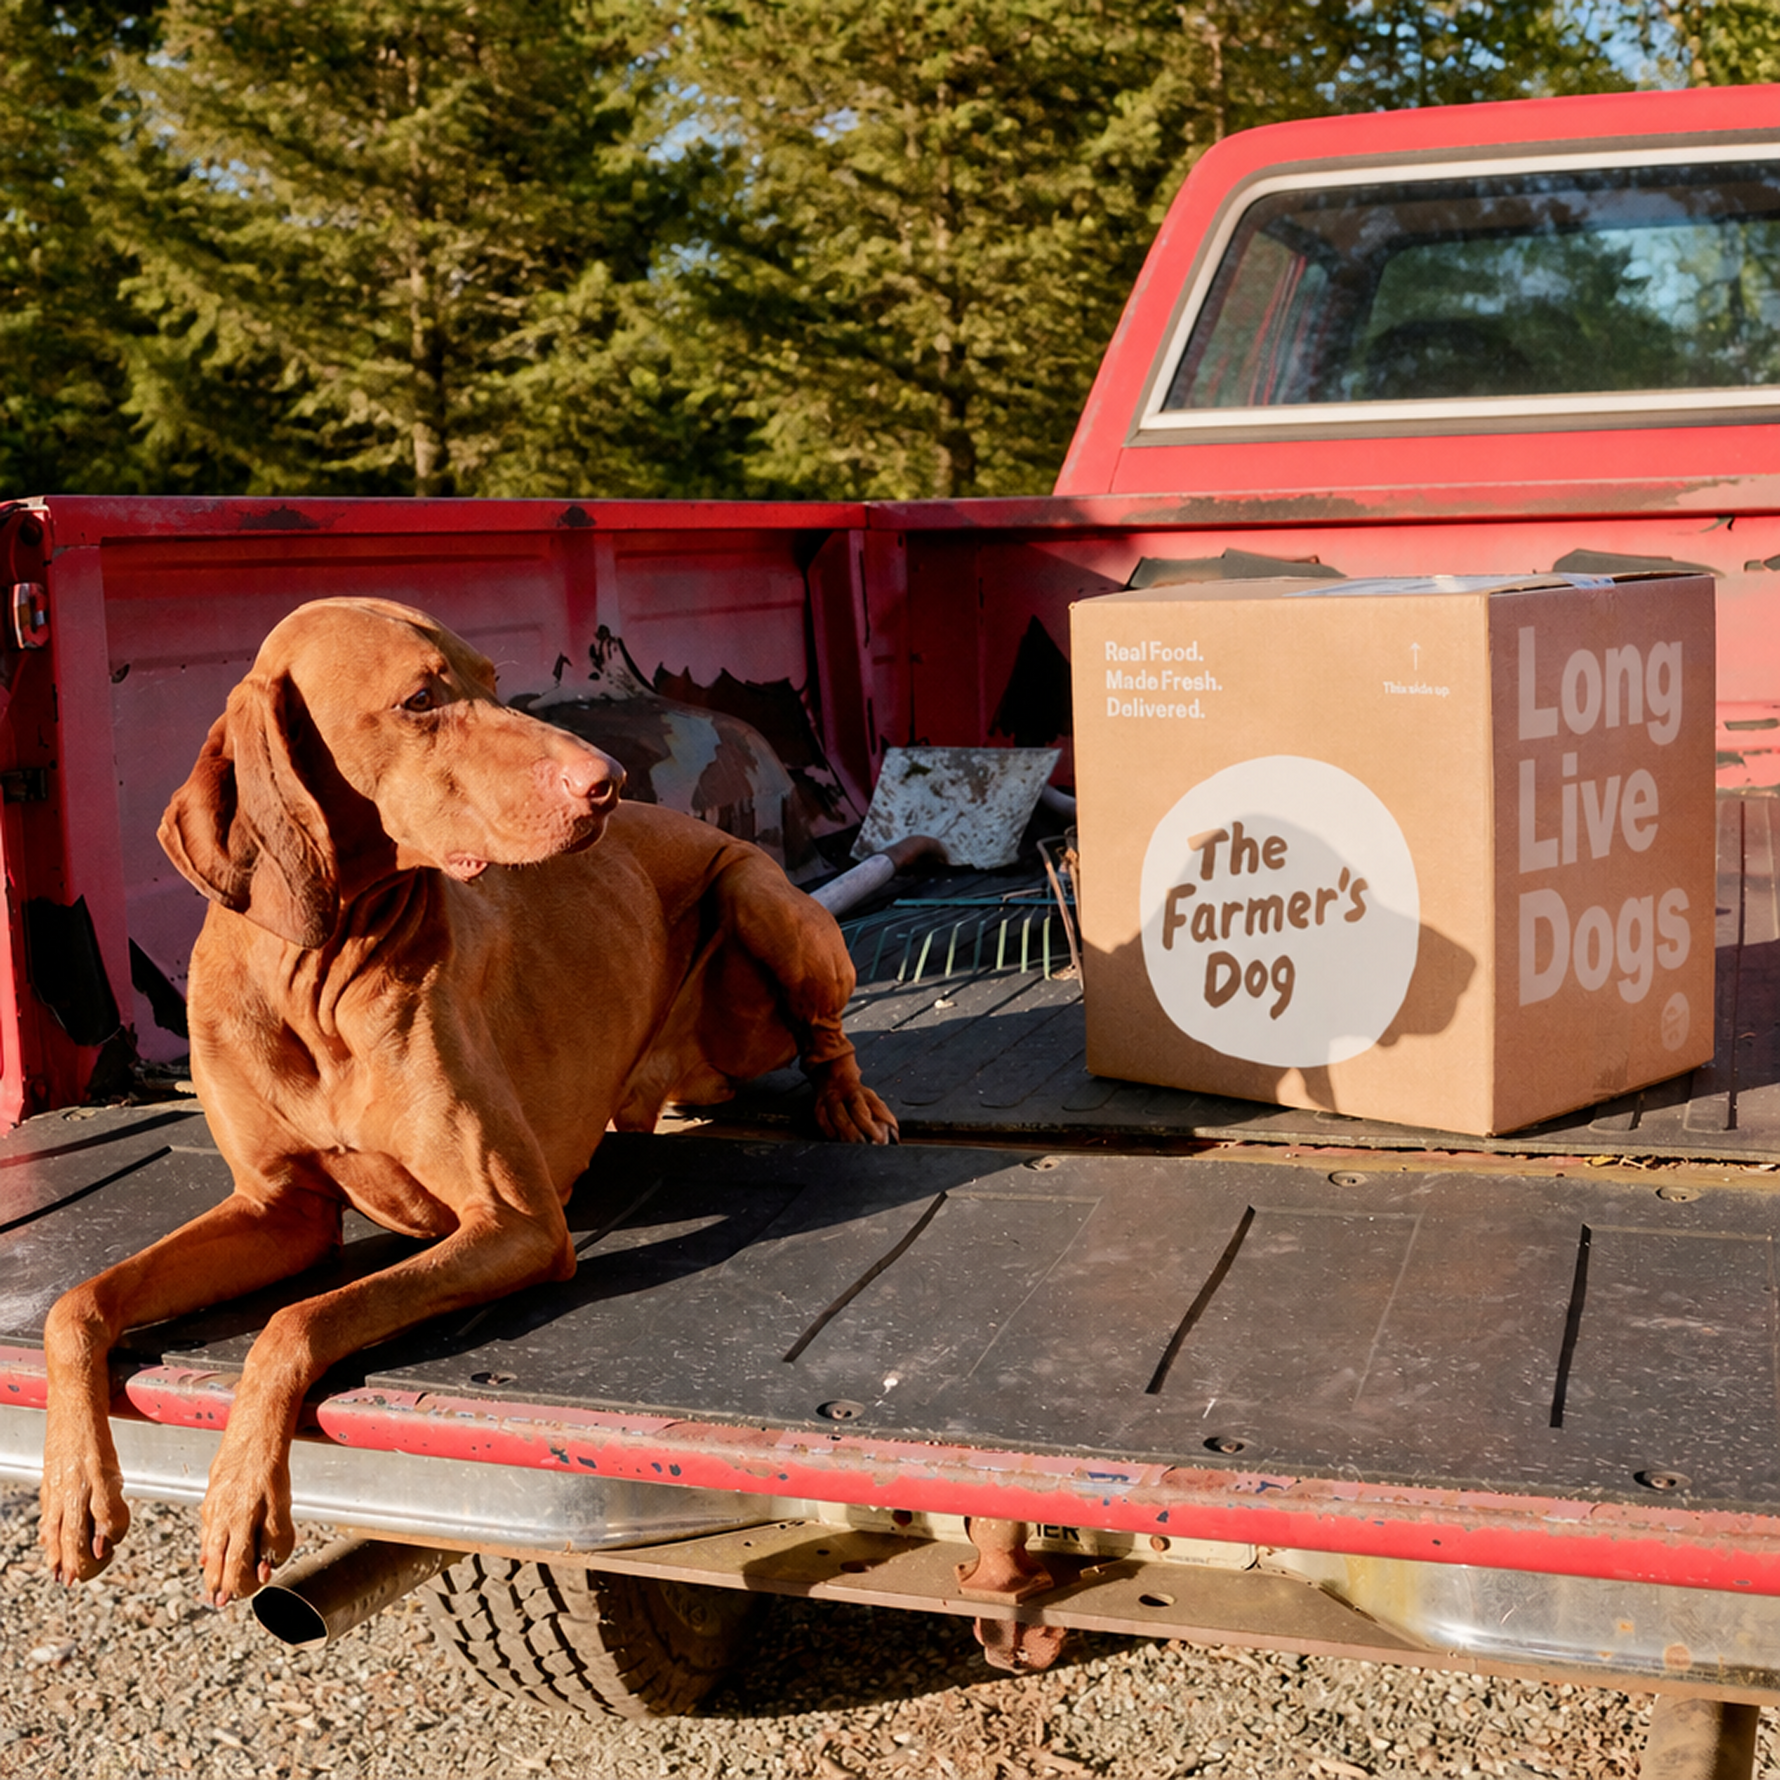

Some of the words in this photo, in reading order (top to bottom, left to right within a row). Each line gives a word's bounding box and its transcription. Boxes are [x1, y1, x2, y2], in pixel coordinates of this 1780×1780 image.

[1105, 641, 1147, 661] Real
[1150, 640, 1204, 661] Food.
[1106, 669, 1158, 690] Made
[1161, 670, 1223, 691] Fresh.
[1107, 697, 1205, 718] Delivered.
[1383, 681, 1407, 694] This
[1434, 686, 1450, 698] up
[1518, 626, 1682, 746] Long
[1518, 752, 1659, 874] Live
[1187, 821, 1288, 881] The
[1162, 867, 1369, 951] Farmer's
[1518, 887, 1691, 1007] Dogs
[1204, 951, 1295, 1020] Dog
